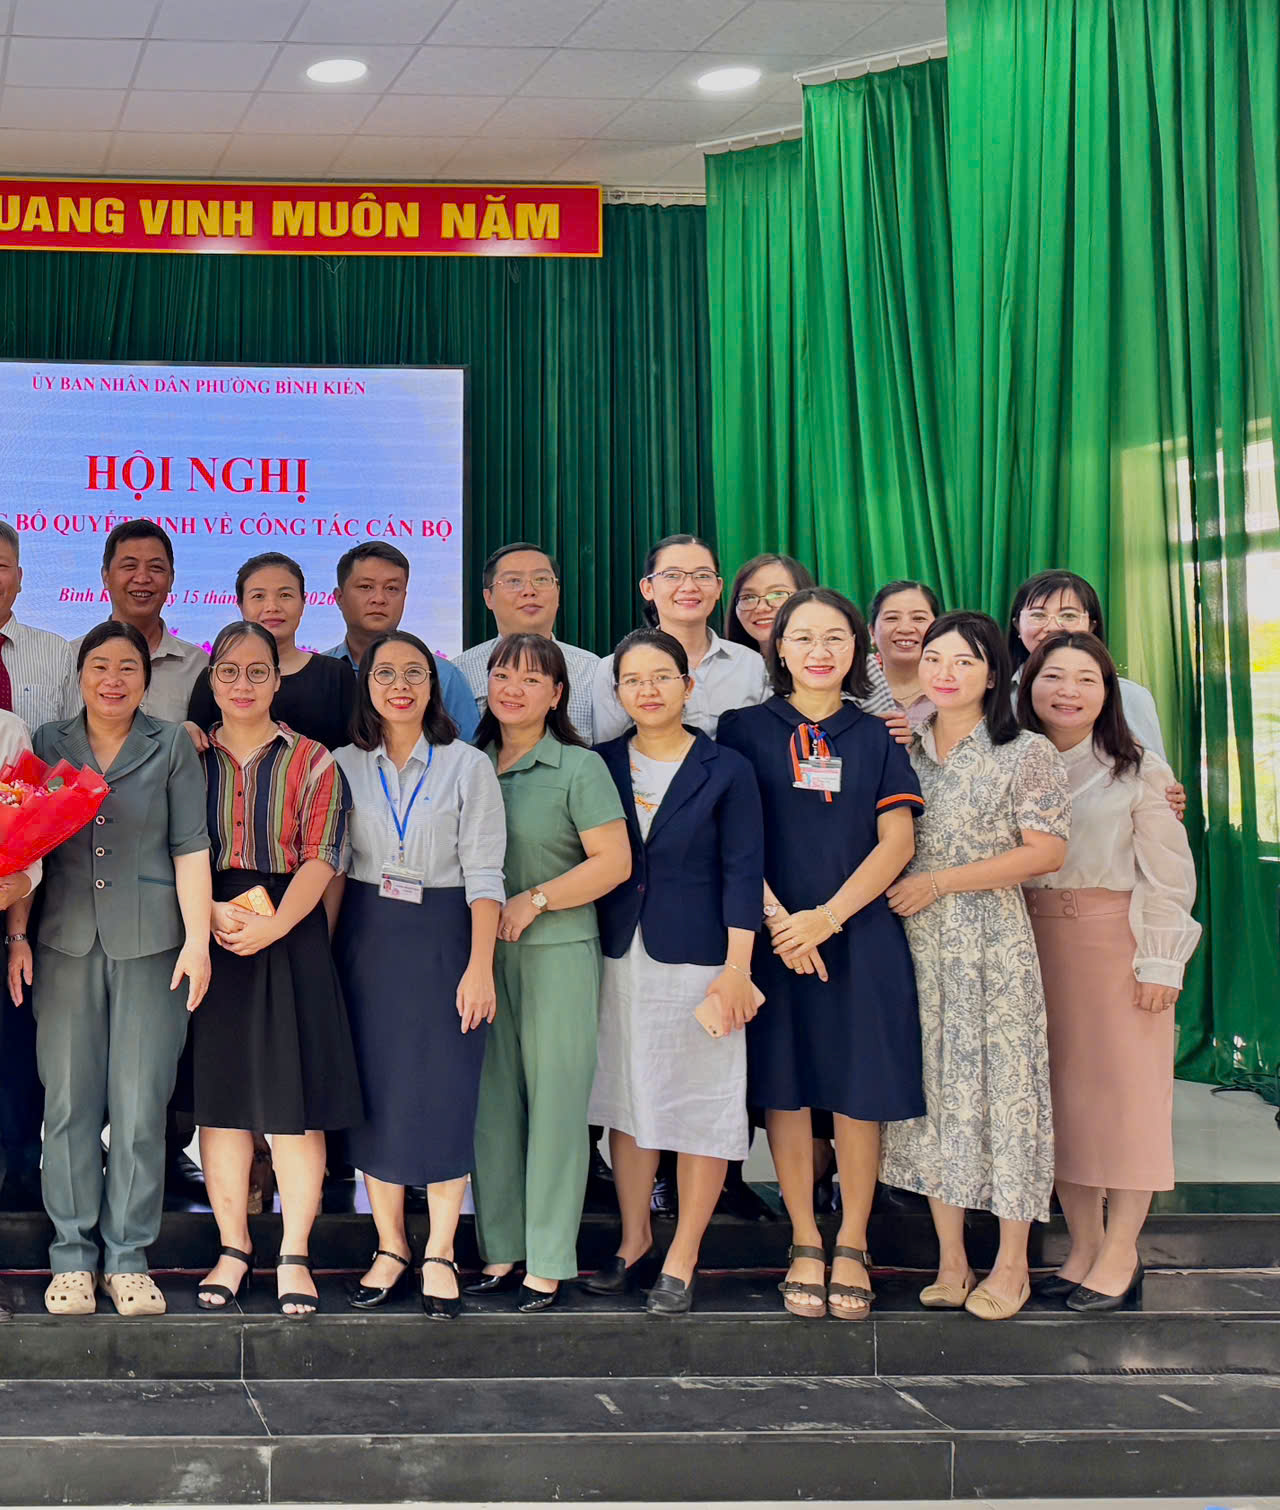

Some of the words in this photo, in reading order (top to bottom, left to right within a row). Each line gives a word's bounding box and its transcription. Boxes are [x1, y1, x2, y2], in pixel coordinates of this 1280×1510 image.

[138, 198, 254, 239] VINH
[272, 191, 421, 239] MUÔN
[440, 194, 561, 241] NĂM
[61, 376, 95, 391] BAN
[100, 374, 150, 393] NHÂN
[155, 375, 191, 393] DÂN
[196, 376, 271, 394] PHƯỜNG
[275, 377, 319, 395] BÌNH
[84, 449, 174, 502] HỘI
[186, 456, 311, 505] NGHỊ
[15, 508, 47, 533] BỐ
[202, 511, 234, 535] VỀ
[239, 511, 308, 537] CÔNG
[311, 512, 361, 537] TÁC
[365, 513, 414, 538] CÁN
[421, 516, 454, 543] BỘ
[58, 587, 95, 602] Bình
[183, 589, 200, 604] 15
